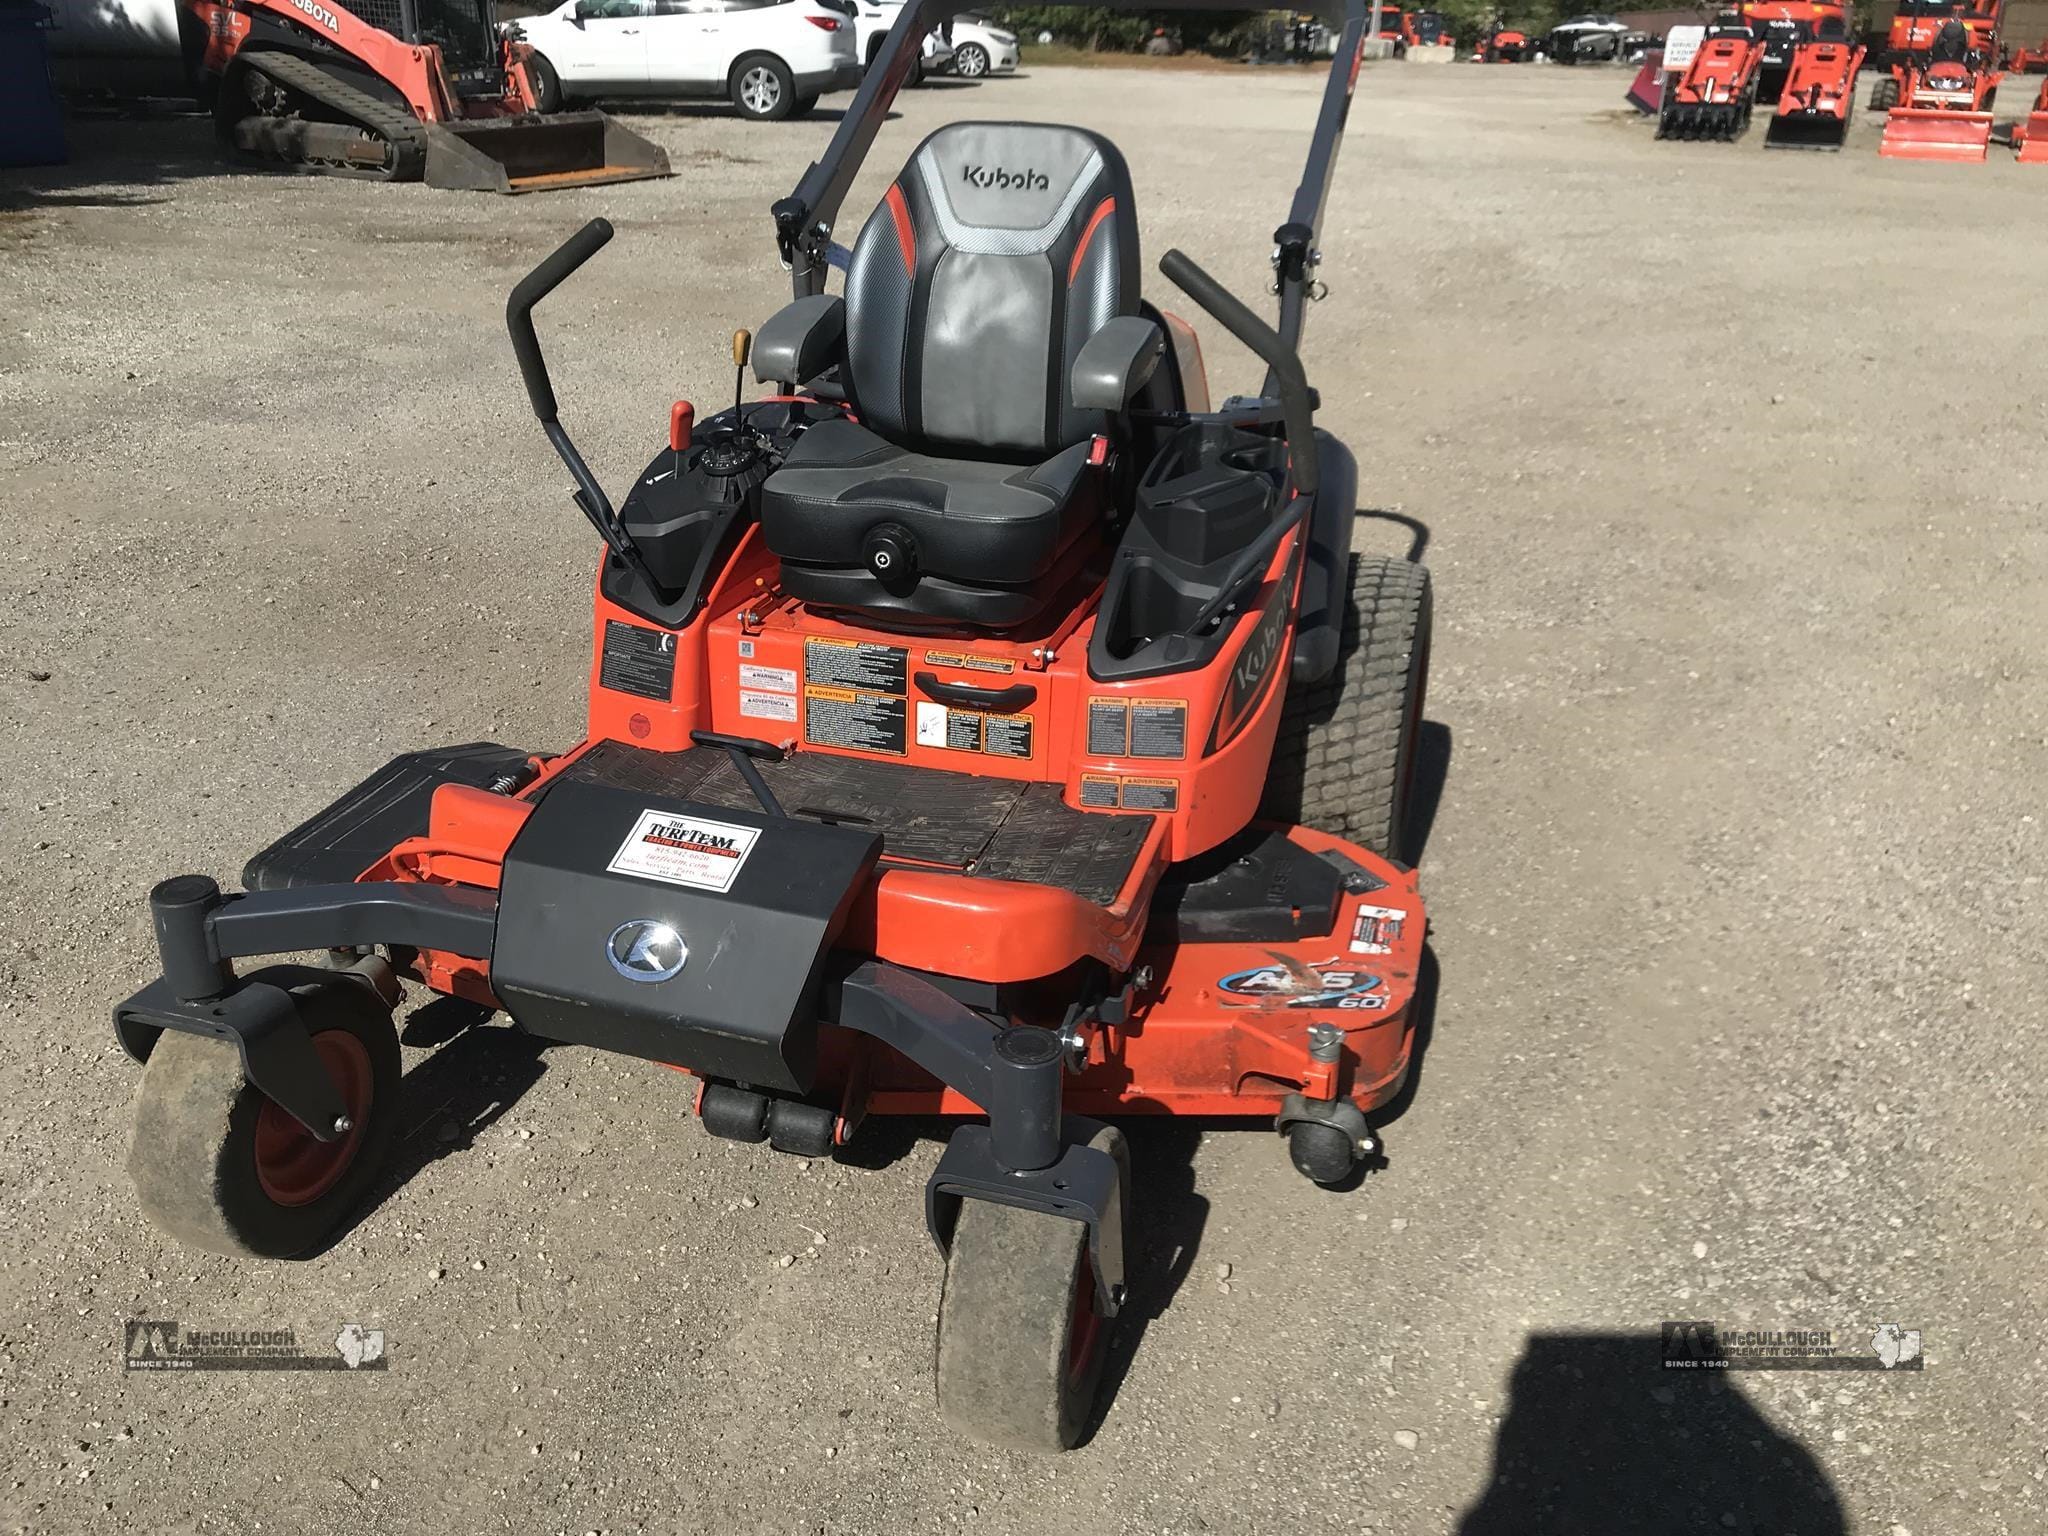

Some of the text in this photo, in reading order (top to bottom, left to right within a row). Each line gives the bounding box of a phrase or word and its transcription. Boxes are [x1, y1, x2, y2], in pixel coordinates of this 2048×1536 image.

[210, 11, 242, 26] SVL
[963, 165, 1050, 190] Kubota
[814, 690, 852, 699] ADVERTENCIA
[669, 820, 686, 828] THE
[646, 853, 710, 870] turfteam.com
[1338, 998, 1384, 1008] 60
